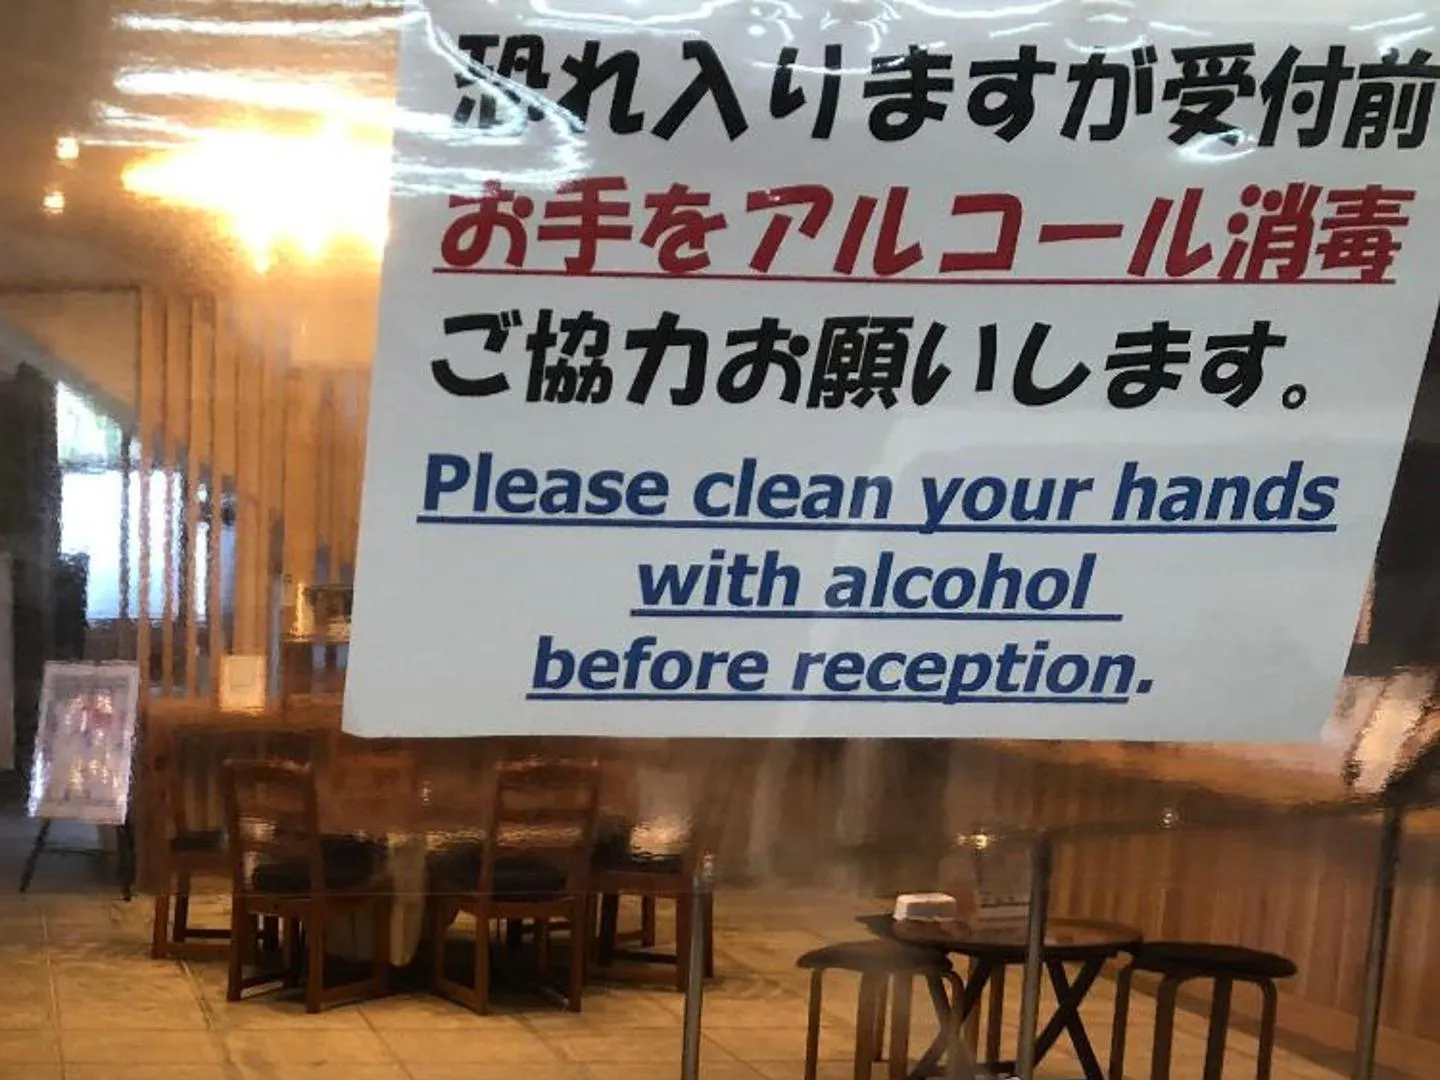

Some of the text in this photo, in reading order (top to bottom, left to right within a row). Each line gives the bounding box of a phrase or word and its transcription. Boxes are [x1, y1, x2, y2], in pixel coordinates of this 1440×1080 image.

[440, 175, 1417, 285] お手をアルコール消毒
[430, 307, 1307, 410] ご協力お願いします。
[422, 452, 1340, 534] Please clean your hands
[637, 549, 1097, 610] with alcohol
[531, 634, 1154, 705] before reception.
